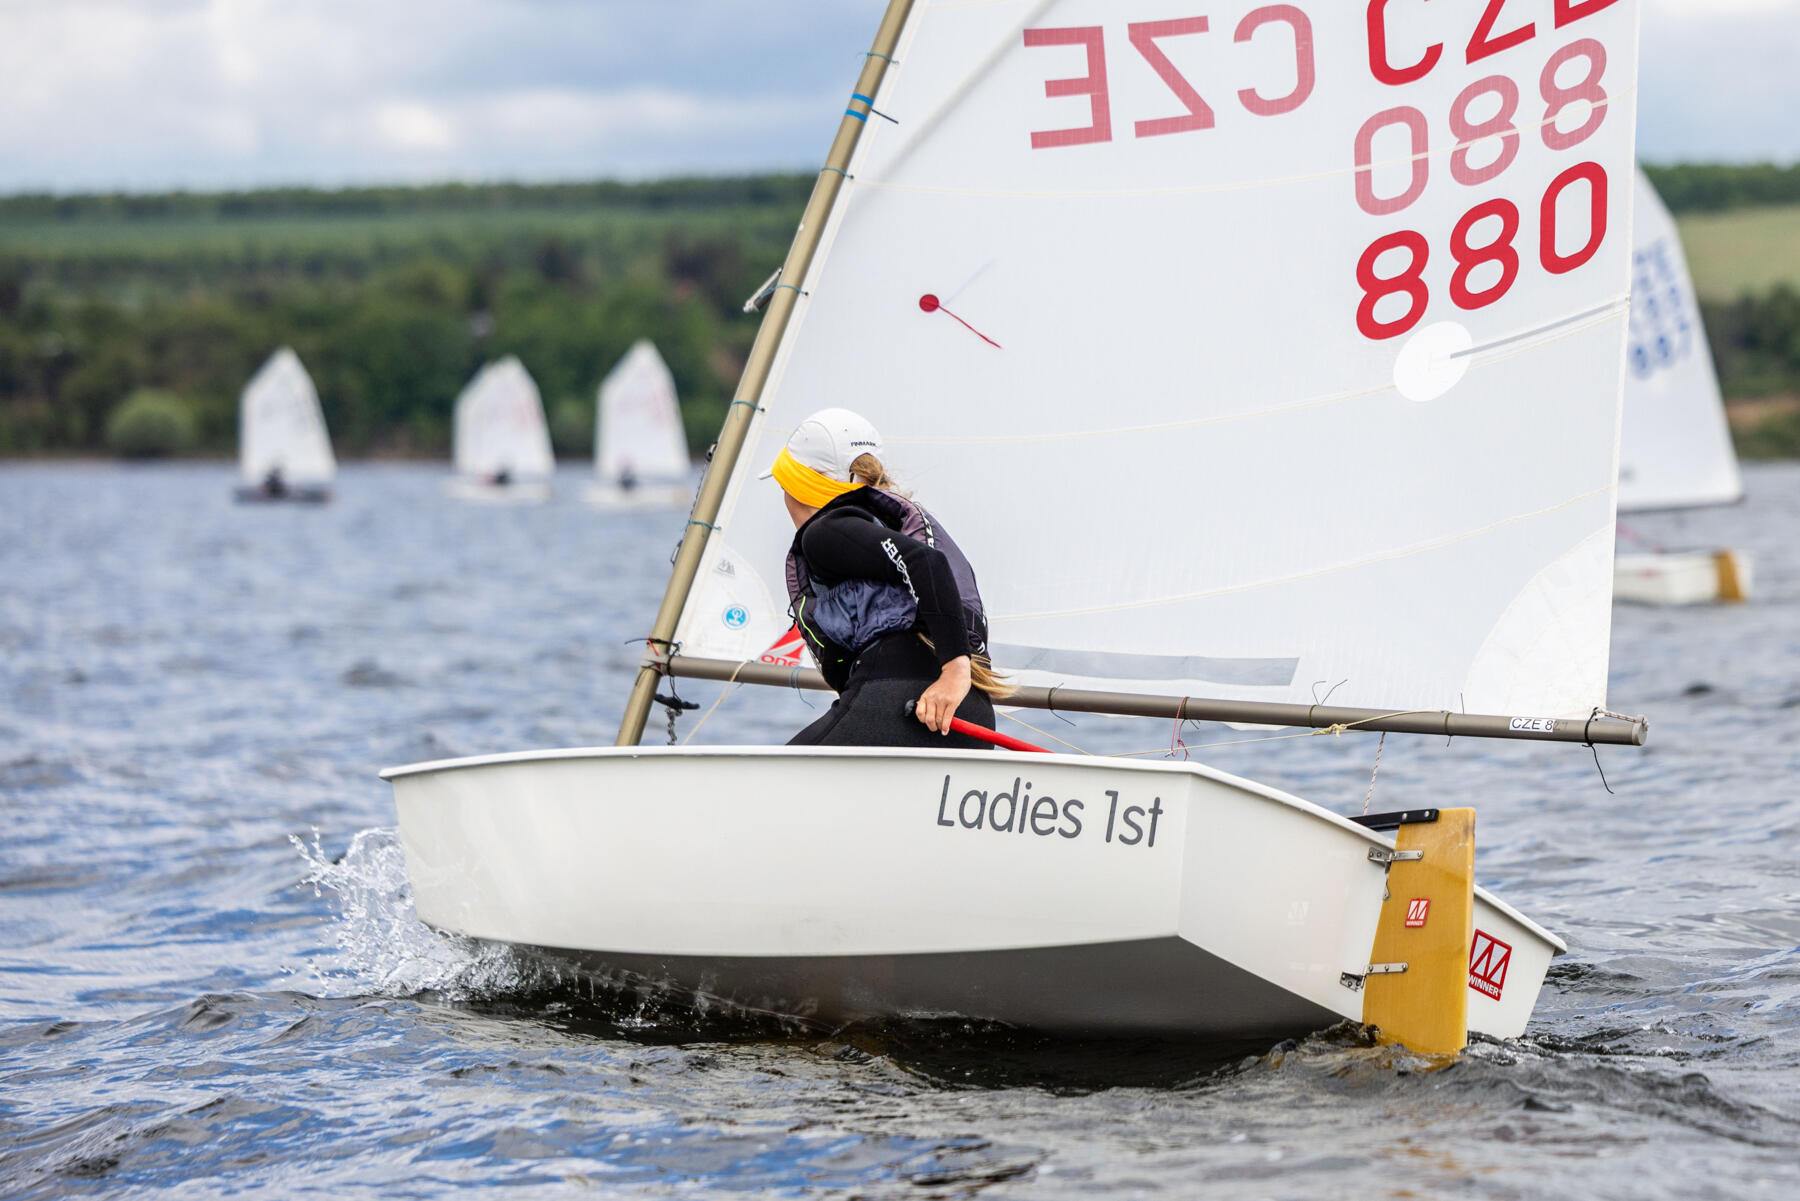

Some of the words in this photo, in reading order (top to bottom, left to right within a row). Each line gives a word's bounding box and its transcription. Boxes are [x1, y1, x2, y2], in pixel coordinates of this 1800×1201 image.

[1366, 0, 1619, 86] CZ
[1356, 161, 1608, 340] 880
[1511, 718, 1542, 730] CZE
[937, 774, 1085, 839] Ladies
[1104, 790, 1164, 848] 1st
